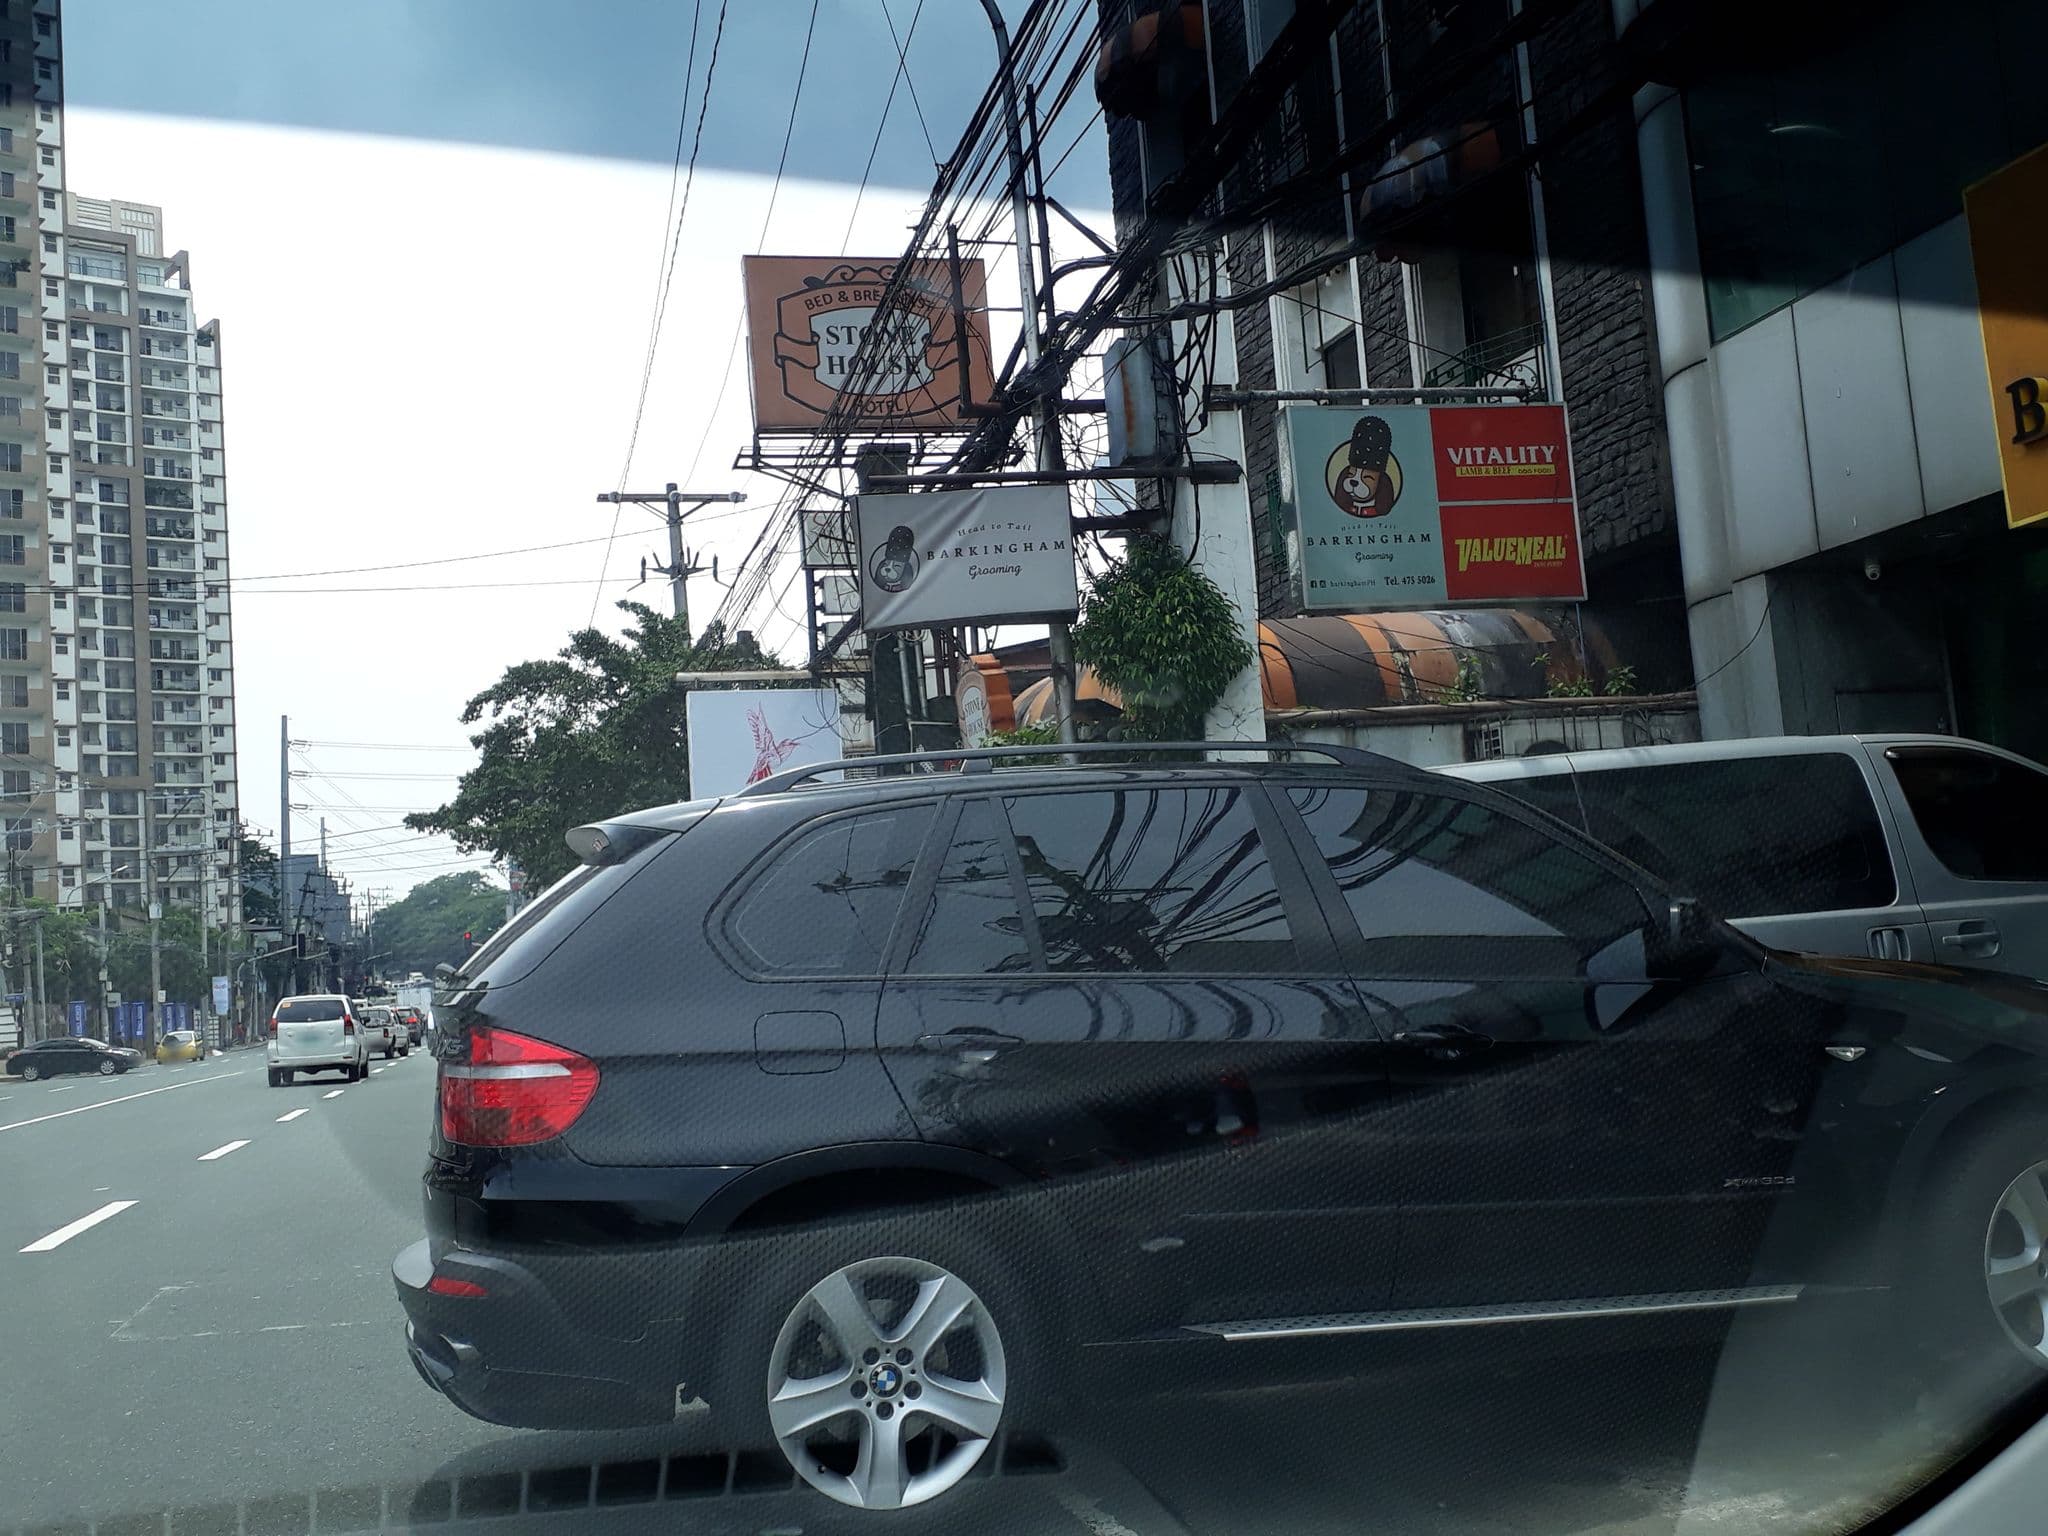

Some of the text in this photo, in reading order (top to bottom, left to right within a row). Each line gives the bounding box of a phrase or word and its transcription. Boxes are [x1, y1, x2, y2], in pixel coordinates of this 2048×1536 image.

[804, 293, 833, 311] BED
[838, 290, 850, 302] &
[826, 325, 917, 346] STONE
[826, 355, 921, 375] HOUSE
[1446, 445, 1555, 465] VITALITY
[1460, 466, 1482, 476] LAMB
[1493, 466, 1511, 475] BEEF
[958, 522, 1033, 537] Head to Tail
[1307, 533, 1431, 546] BARKINGHAM
[926, 540, 1066, 561] BARKINGHAM
[1354, 551, 1394, 563] Grooming
[1455, 536, 1566, 572] VALUEMEAL
[968, 564, 1022, 580] Grooming
[1401, 576, 1415, 585] 475
[1417, 575, 1436, 585] 5026
